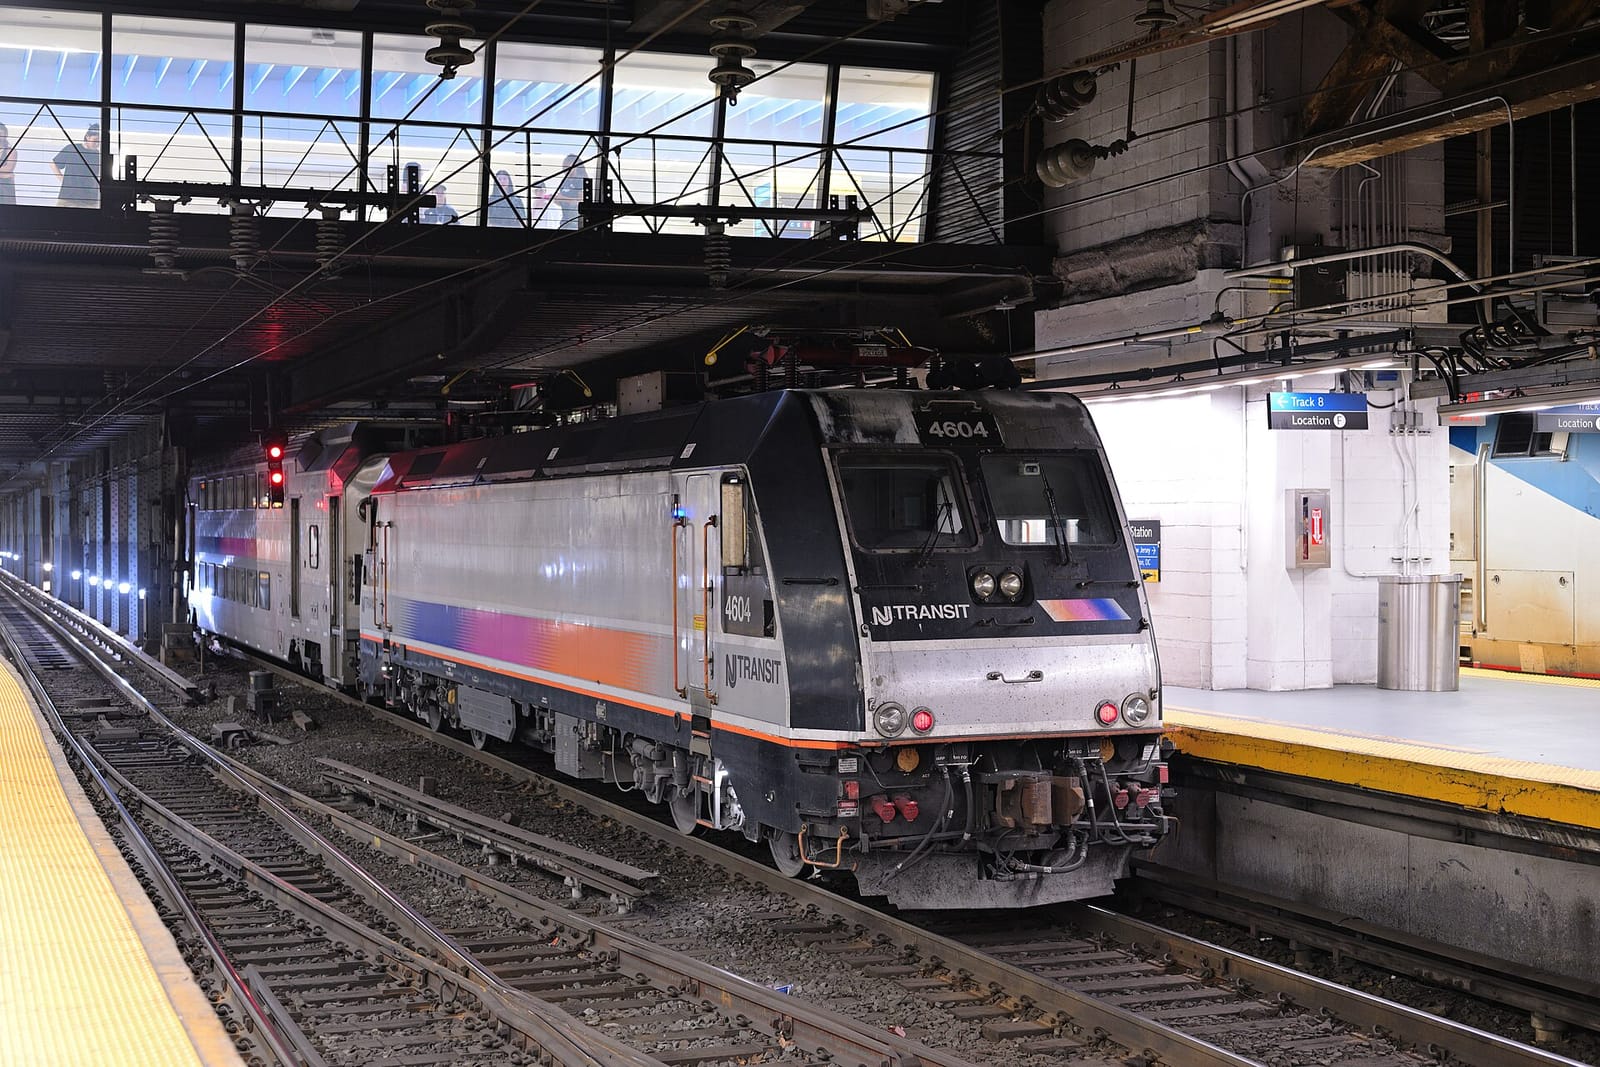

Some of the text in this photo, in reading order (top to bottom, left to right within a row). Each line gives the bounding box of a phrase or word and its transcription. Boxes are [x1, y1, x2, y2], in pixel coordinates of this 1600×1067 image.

[1291, 396, 1324, 407] Track 8
[1292, 415, 1331, 426] Location
[1558, 418, 1593, 428] Location
[929, 421, 989, 438] 4604
[1130, 525, 1153, 538] Station
[725, 595, 751, 623] 4604
